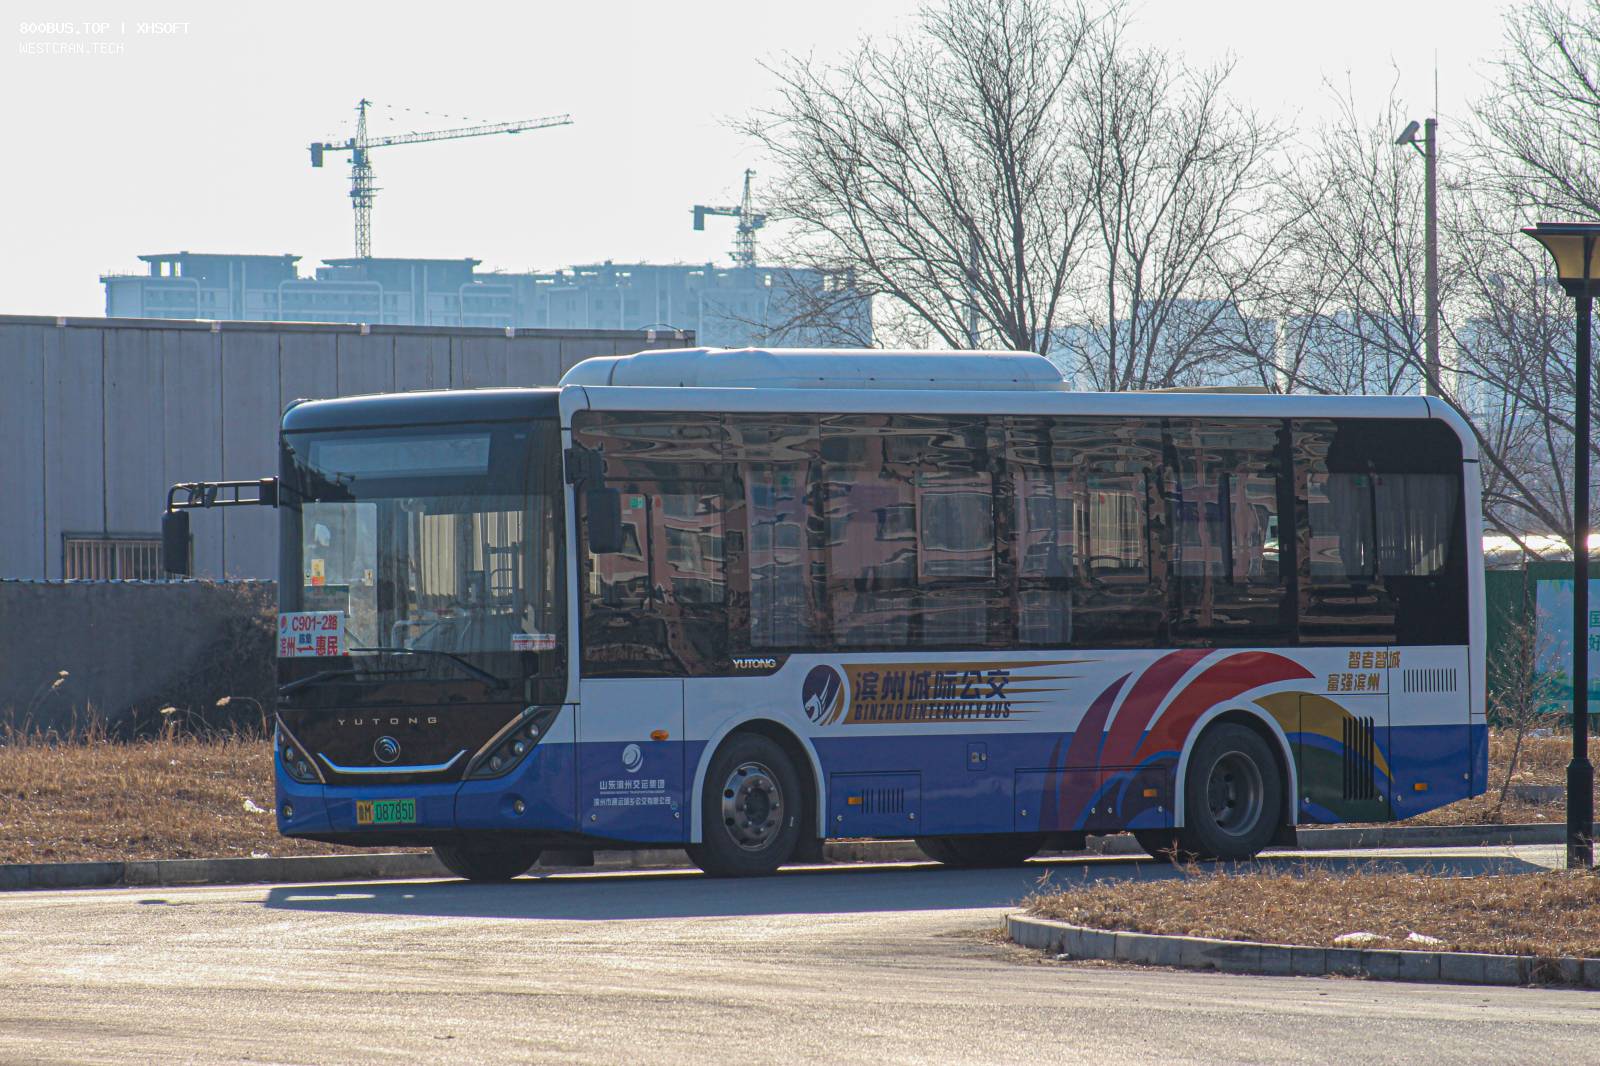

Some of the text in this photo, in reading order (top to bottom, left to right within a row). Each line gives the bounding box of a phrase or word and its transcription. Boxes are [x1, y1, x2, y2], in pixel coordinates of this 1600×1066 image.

[291, 615, 338, 631] C901-2路
[315, 635, 338, 656] 惠民
[732, 658, 776, 669] YUTONG
[1348, 650, 1401, 669] 智者智城
[854, 669, 1011, 701] 滨州城际公交
[1327, 672, 1380, 692] 富强滨州
[338, 716, 437, 726] YUTONG
